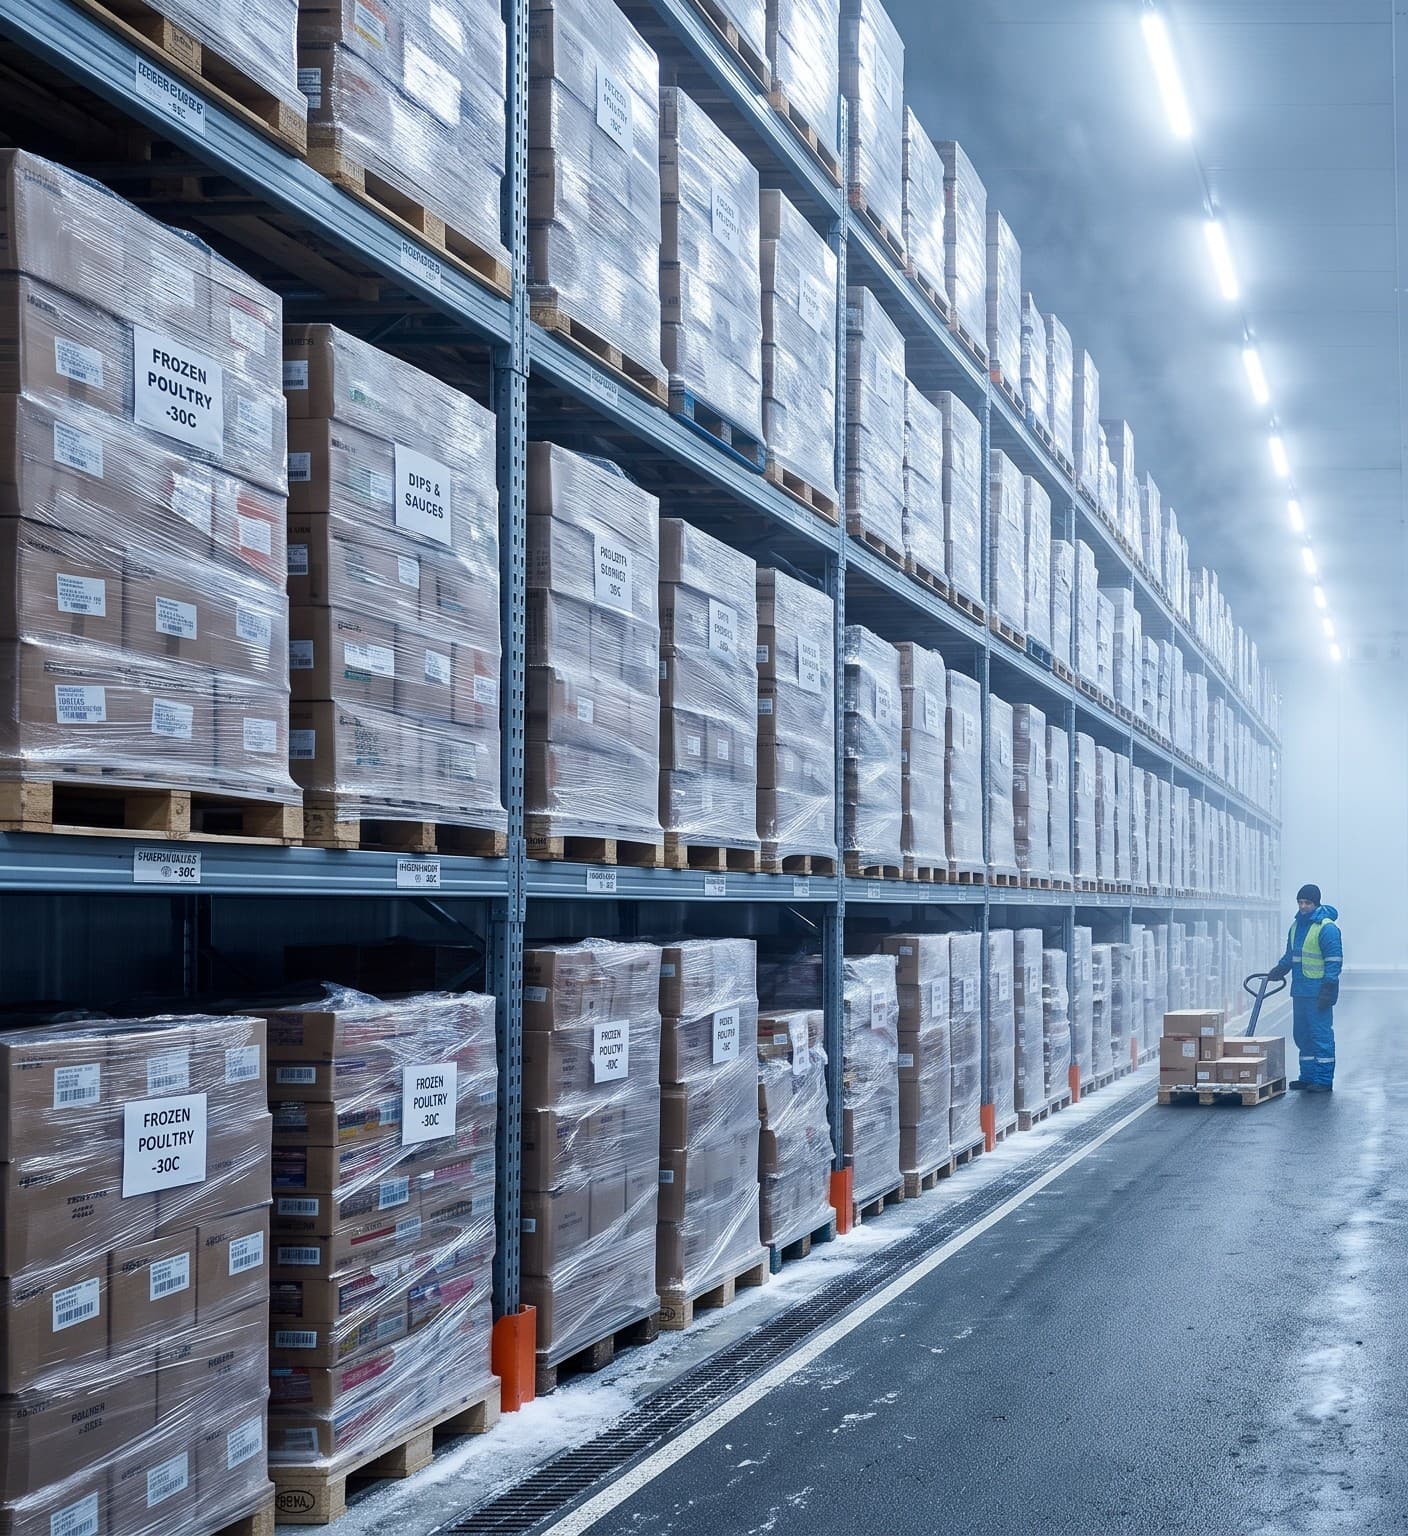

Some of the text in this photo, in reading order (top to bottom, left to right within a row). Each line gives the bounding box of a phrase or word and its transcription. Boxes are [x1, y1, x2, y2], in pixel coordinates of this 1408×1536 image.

[152, 348, 207, 385] FROZEN
[147, 371, 212, 410] POULTRY
[166, 406, 197, 428] -30C
[409, 472, 441, 498] DIPS &
[405, 492, 444, 519] SAUCES
[174, 866, 196, 878] -30C
[416, 1075, 444, 1090] FROZEN
[413, 1093, 448, 1110] POULTRY
[143, 1107, 191, 1128] FROZEN
[421, 1113, 440, 1127] -30C
[138, 1130, 195, 1153] POULTRY
[151, 1156, 180, 1174] -30C
